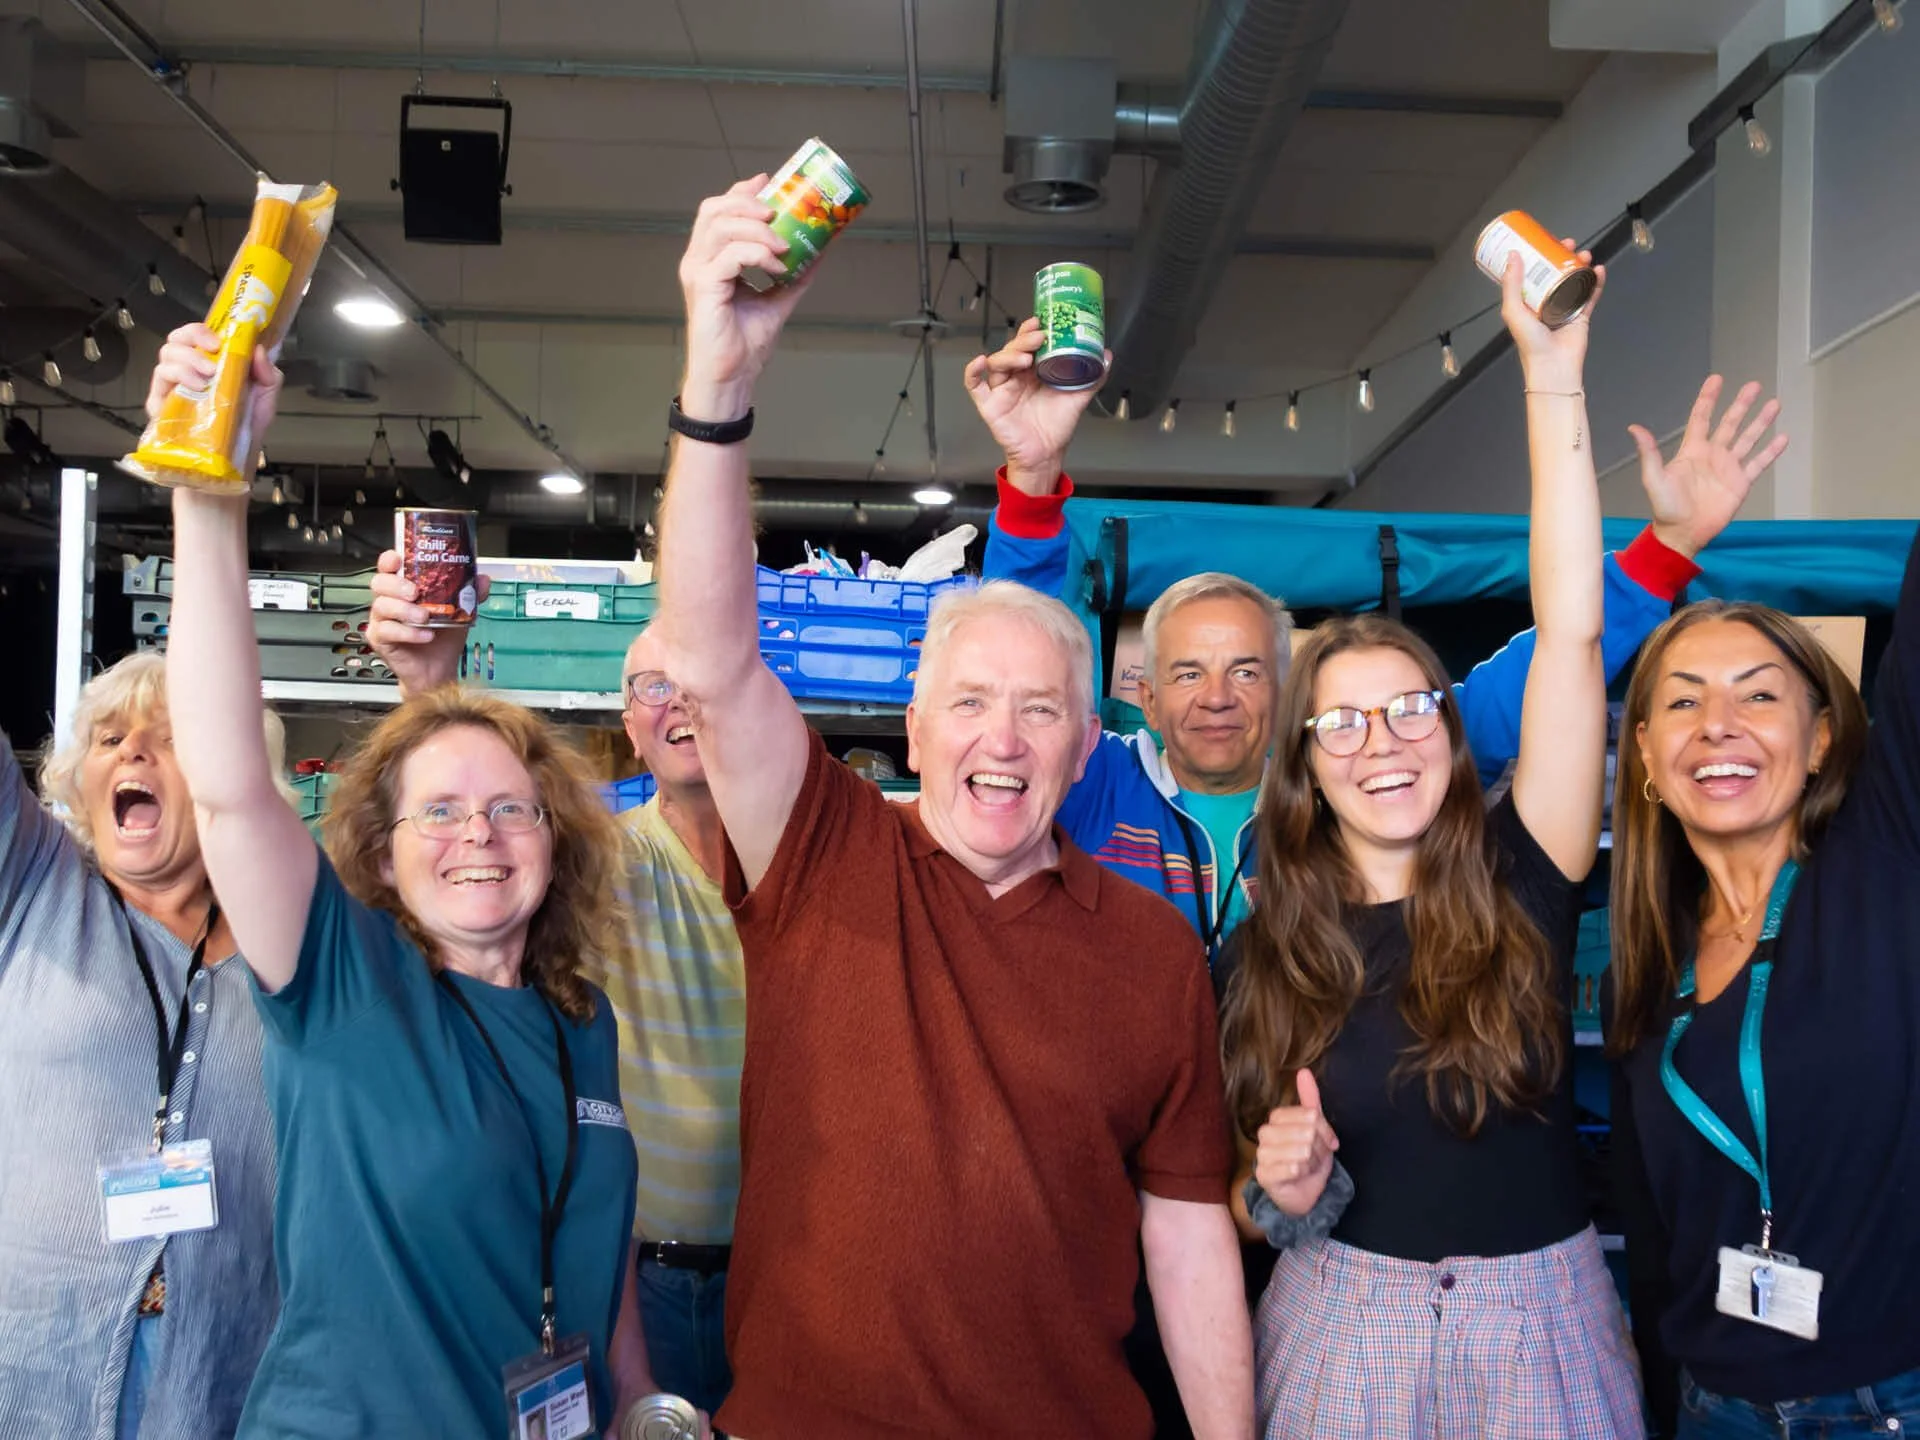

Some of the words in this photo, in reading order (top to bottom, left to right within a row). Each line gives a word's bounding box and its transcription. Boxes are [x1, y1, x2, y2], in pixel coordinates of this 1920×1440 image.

[416, 539, 447, 551] Chilli
[416, 551, 439, 562] Con
[441, 552, 470, 564] Carne
